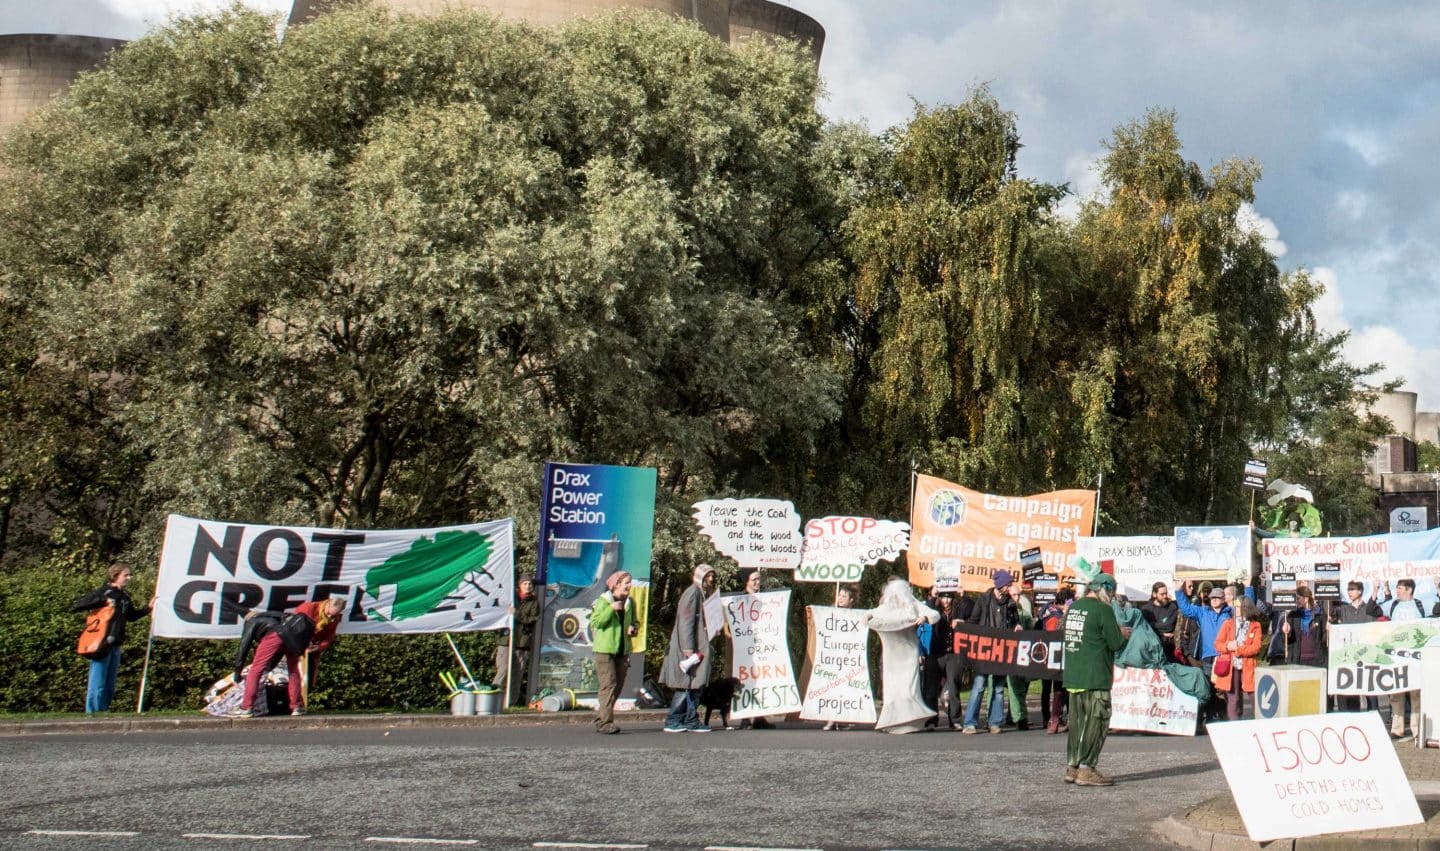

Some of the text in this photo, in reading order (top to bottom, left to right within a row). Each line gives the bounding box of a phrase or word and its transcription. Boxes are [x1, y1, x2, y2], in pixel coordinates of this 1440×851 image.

[553, 469, 591, 486] Drax
[552, 488, 603, 505] Power
[550, 506, 605, 525] Station
[710, 505, 738, 517] leave
[746, 507, 764, 517] the
[983, 494, 1083, 523] Campaign
[711, 518, 762, 527] in the hole
[808, 517, 877, 538] STOP
[727, 530, 744, 539] and
[749, 531, 764, 540] the
[1005, 521, 1081, 543] against
[187, 524, 366, 581] NOT
[736, 542, 744, 552] in
[749, 542, 766, 553] the
[868, 544, 896, 561] COAL
[919, 535, 995, 560] Climate
[1098, 544, 1163, 558] DRAX BIOMASS
[1264, 539, 1388, 558] Drax Power Station
[800, 563, 861, 580] WOOD
[1277, 558, 1313, 574] Dinosau
[1355, 565, 1379, 580] Axe
[1382, 564, 1401, 578] the
[825, 612, 860, 632] drax
[748, 644, 778, 655] DRAX
[953, 631, 1065, 670] FIGHTBAC
[820, 652, 861, 671] largest
[738, 663, 787, 681] BURN
[813, 664, 838, 681] Green
[1252, 725, 1371, 773] 15,000
[1274, 778, 1379, 800] DEATHS FROM
[1291, 797, 1383, 819] COLD HOMES
